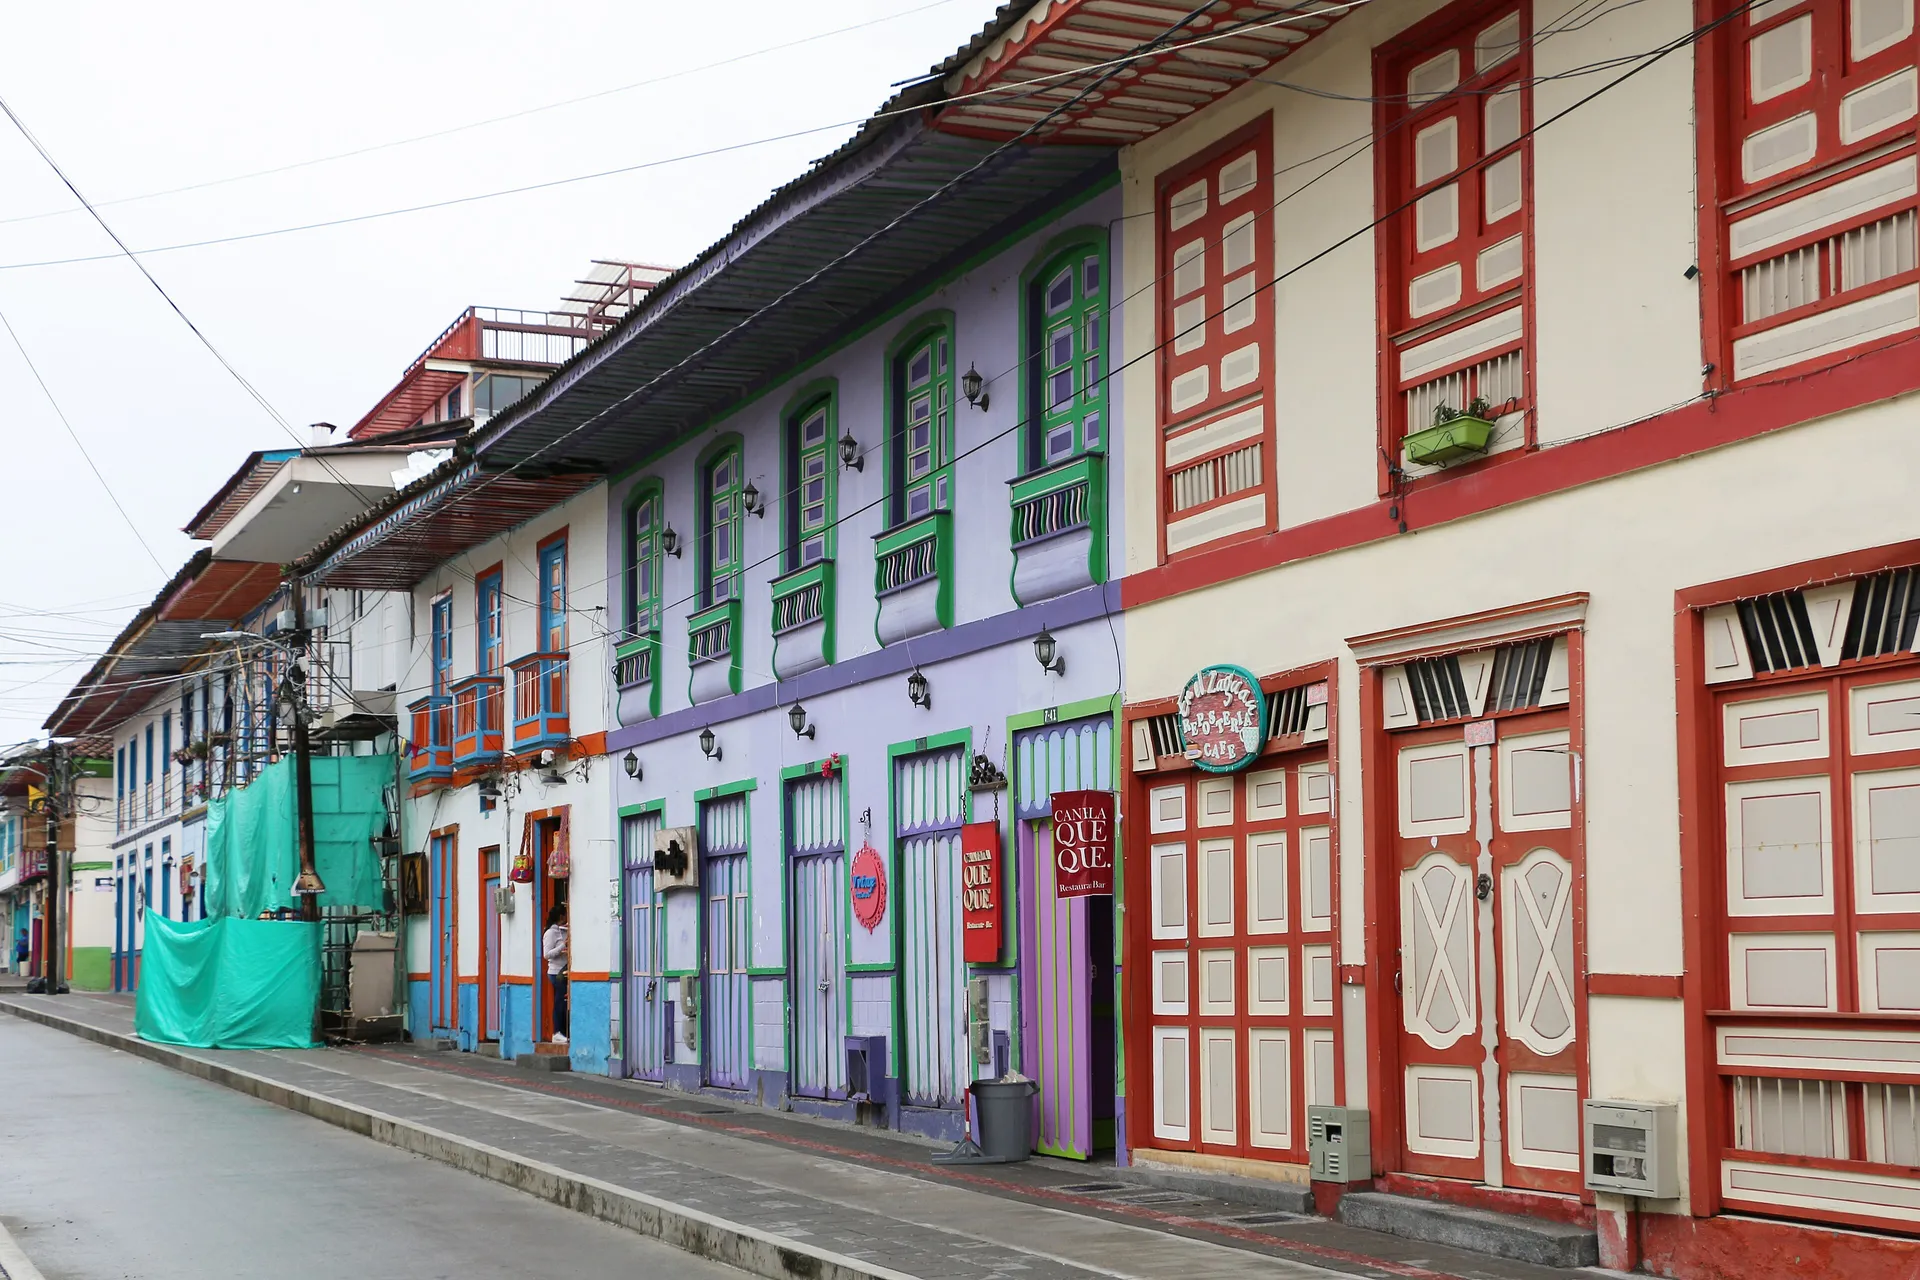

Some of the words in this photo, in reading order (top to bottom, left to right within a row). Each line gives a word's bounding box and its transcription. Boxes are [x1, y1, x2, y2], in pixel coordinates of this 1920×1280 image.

[1182, 710, 1253, 736] REPOSTERIA
[1203, 741, 1236, 759] CAFE
[1055, 820, 1107, 847] QUE
[1057, 846, 1112, 874] QUE.
[964, 865, 992, 888] QUE
